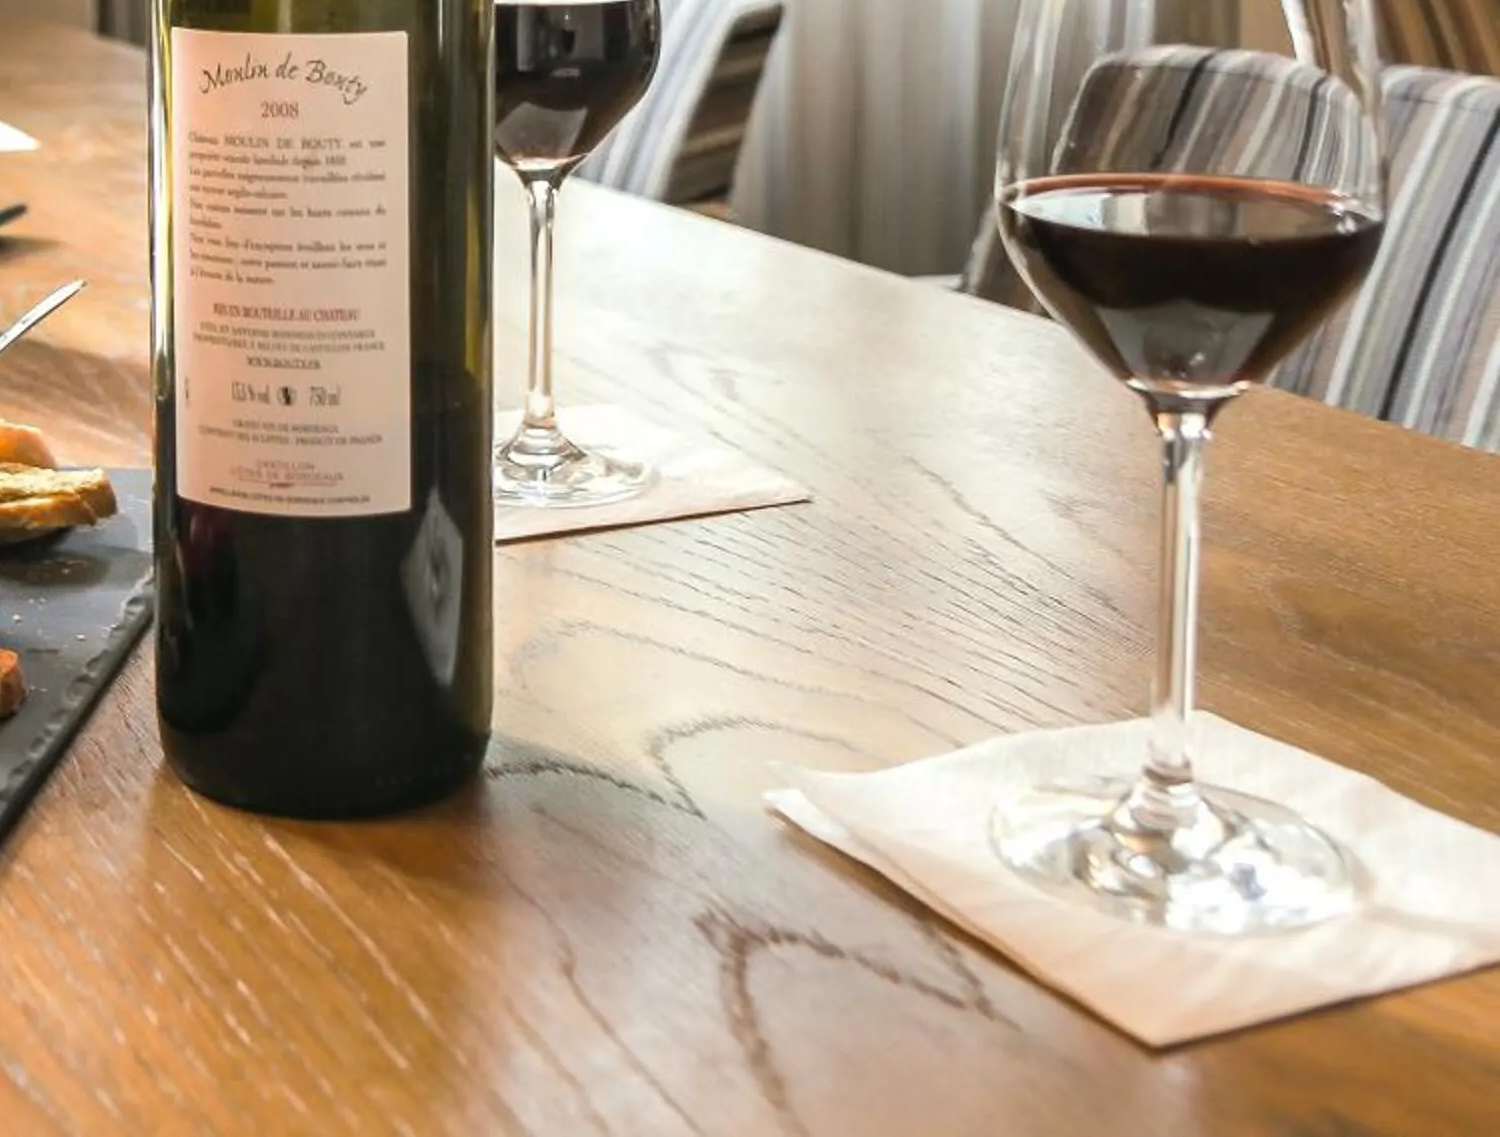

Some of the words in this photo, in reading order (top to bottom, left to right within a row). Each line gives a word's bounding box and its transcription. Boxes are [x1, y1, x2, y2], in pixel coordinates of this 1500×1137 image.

[201, 51, 269, 94] Moulin
[275, 51, 299, 80] de
[305, 59, 368, 105] Bouty
[260, 100, 299, 118] 2008
[276, 137, 293, 149] DE
